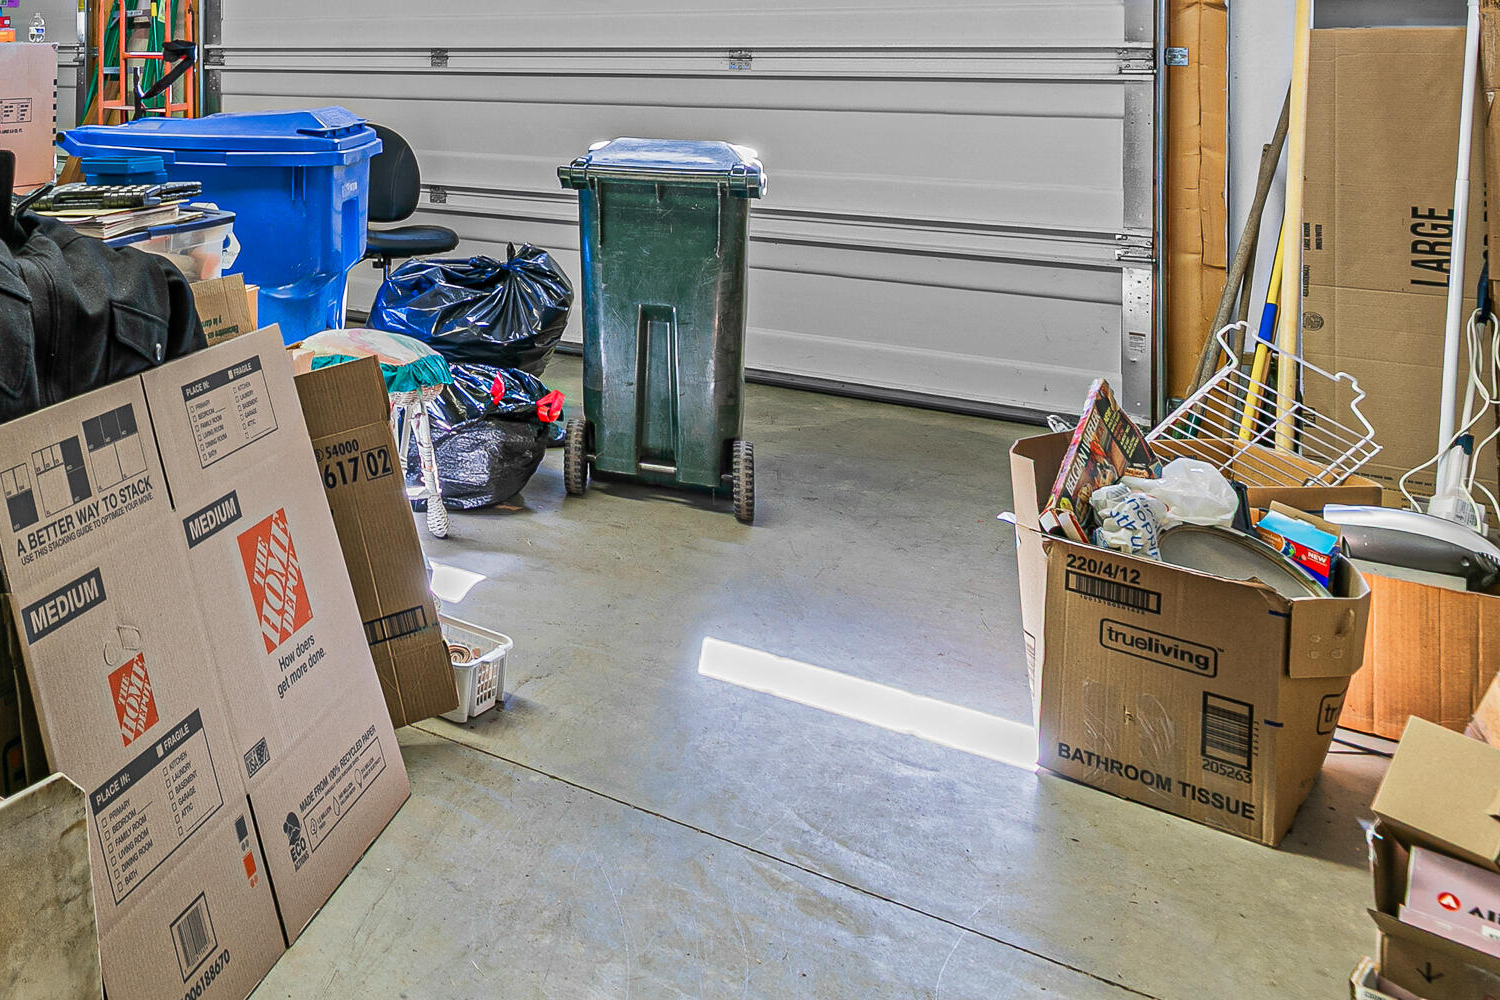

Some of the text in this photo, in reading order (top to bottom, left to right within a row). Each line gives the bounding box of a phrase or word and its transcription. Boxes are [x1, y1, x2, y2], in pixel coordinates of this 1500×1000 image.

[1410, 206, 1453, 288] LARGE
[232, 362, 252, 377] FRAGILE
[185, 383, 202, 397] PLACE
[326, 439, 359, 460] 54000
[324, 450, 391, 489] 617 02
[1065, 453, 1088, 497] BELGIAN
[16, 476, 153, 557] A BETTER WAY TO STACK
[188, 497, 237, 541] MEDIUM
[21, 553, 34, 566] USE
[34, 546, 48, 560] THIS
[48, 533, 77, 554] STACKING
[76, 525, 93, 539] GUIDE
[93, 520, 102, 530] TO
[101, 506, 125, 525] OPTIMIZE
[124, 502, 138, 516] YOUR
[252, 536, 268, 587] THE
[1066, 554, 1141, 585] 220/4/12
[1307, 550, 1328, 564] NEW
[261, 511, 289, 647] HOME
[282, 549, 299, 635] DEPOT
[29, 577, 100, 634] MEDIUM
[278, 634, 315, 672] How doers
[1107, 625, 1210, 671] trueliving
[118, 673, 130, 705] THE
[277, 676, 291, 699] get
[290, 663, 308, 684] more
[122, 654, 147, 741] HOME
[136, 677, 152, 734] DEPOT
[163, 724, 190, 750] FRAGILE
[168, 750, 188, 770] KITCHEN
[171, 761, 192, 782] LAUNDRY
[299, 794, 315, 813] MADE
[313, 776, 329, 798] FROM
[339, 740, 363, 771] RECYCLED
[361, 724, 377, 744] PAPER
[1202, 759, 1253, 784] 205263
[95, 773, 131, 806] PLACE IN:
[174, 770, 198, 795] BASEMENT
[178, 786, 196, 806] GARAGE
[1057, 742, 1256, 821] BATHROOM TISSUE
[109, 798, 131, 821] PRIMARY
[112, 808, 137, 834] BEDROOM
[181, 802, 194, 818] ATTIC
[114, 815, 147, 848] FAMILY ROOM
[118, 828, 150, 860] LIVING ROOM
[122, 841, 154, 872] DINING ROOM
[290, 837, 307, 862] ECO
[294, 851, 310, 872] ACTIONS
[124, 869, 139, 885] BATH
[180, 949, 230, 1000] 006188670
